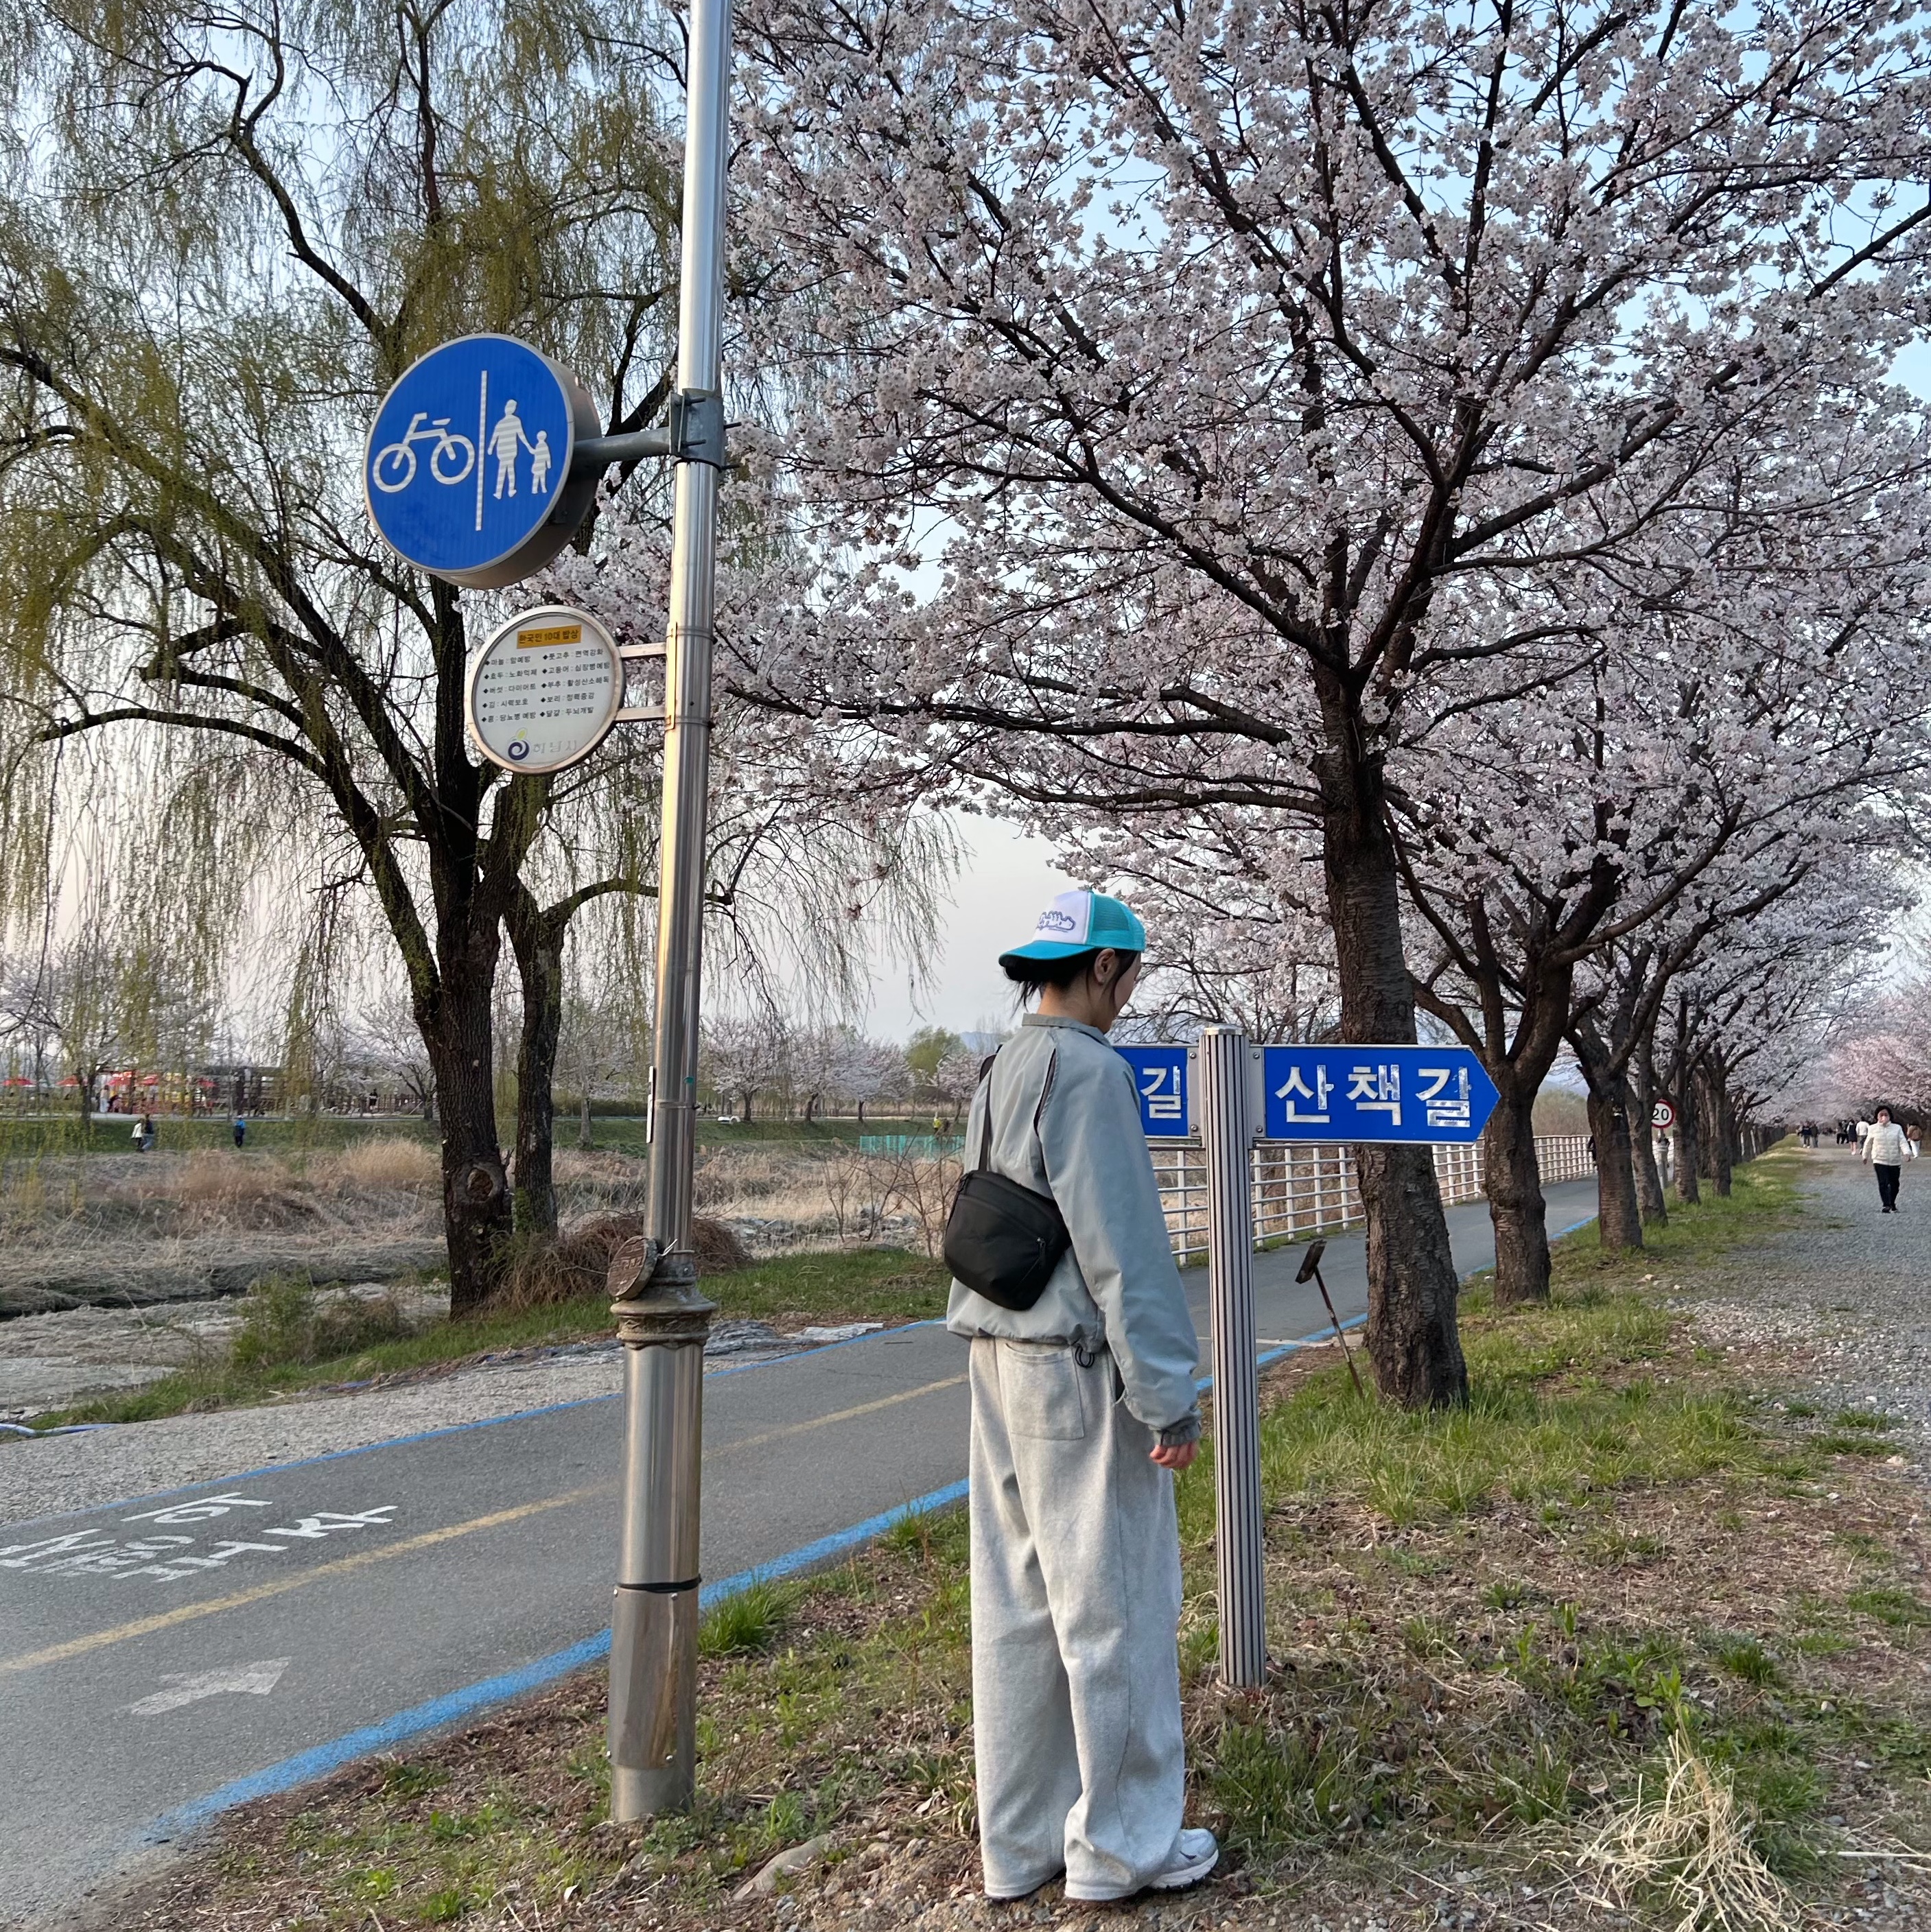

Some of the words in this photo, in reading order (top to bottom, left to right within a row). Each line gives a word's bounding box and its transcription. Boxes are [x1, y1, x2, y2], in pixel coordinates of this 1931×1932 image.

[519, 633, 542, 644] 한국인
[544, 631, 560, 640] 10대
[563, 630, 578, 639] 밥상
[549, 652, 569, 660] 풋고추
[576, 648, 603, 657] 면역강화
[509, 669, 537, 677] 노화억제
[508, 683, 536, 692] 다이어트
[501, 698, 528, 707] 시력보호
[565, 707, 594, 716] 두뇌개발
[1652, 1109, 1669, 1120] 20
